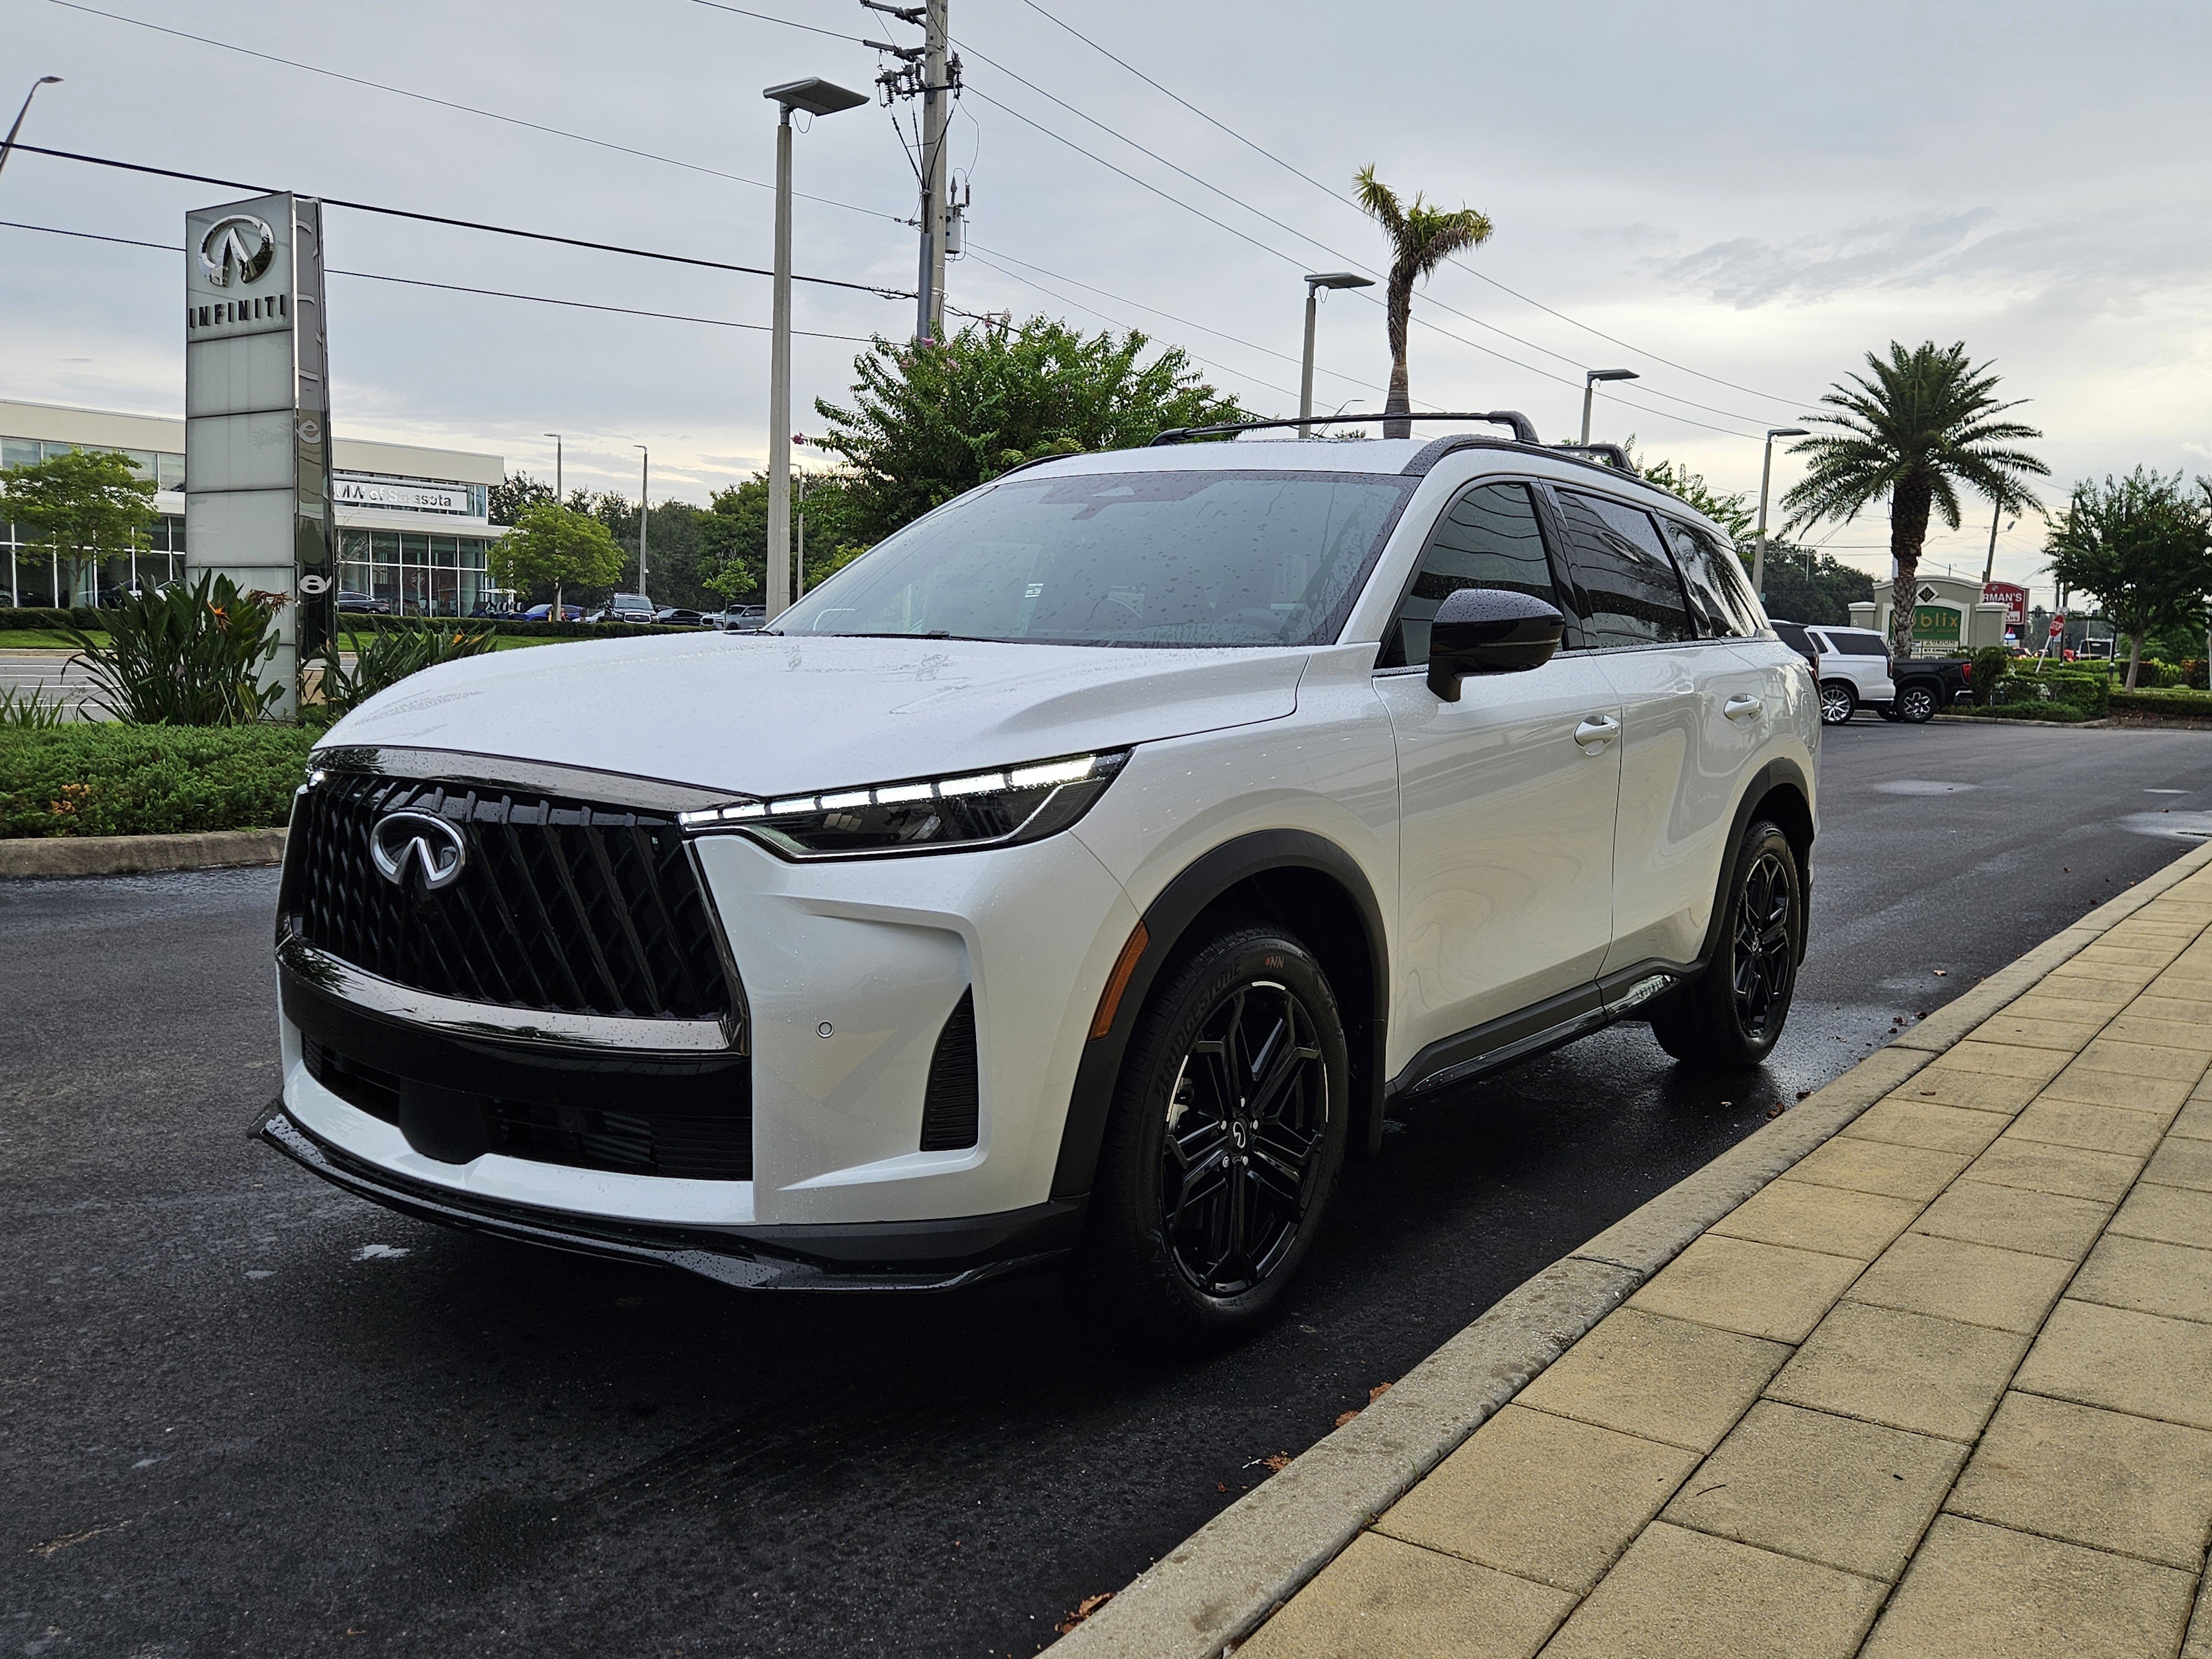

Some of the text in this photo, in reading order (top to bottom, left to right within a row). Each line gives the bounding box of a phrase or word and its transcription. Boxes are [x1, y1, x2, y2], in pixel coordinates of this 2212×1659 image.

[189, 294, 286, 328] INFINITI
[333, 484, 451, 507] MW of Sarasota
